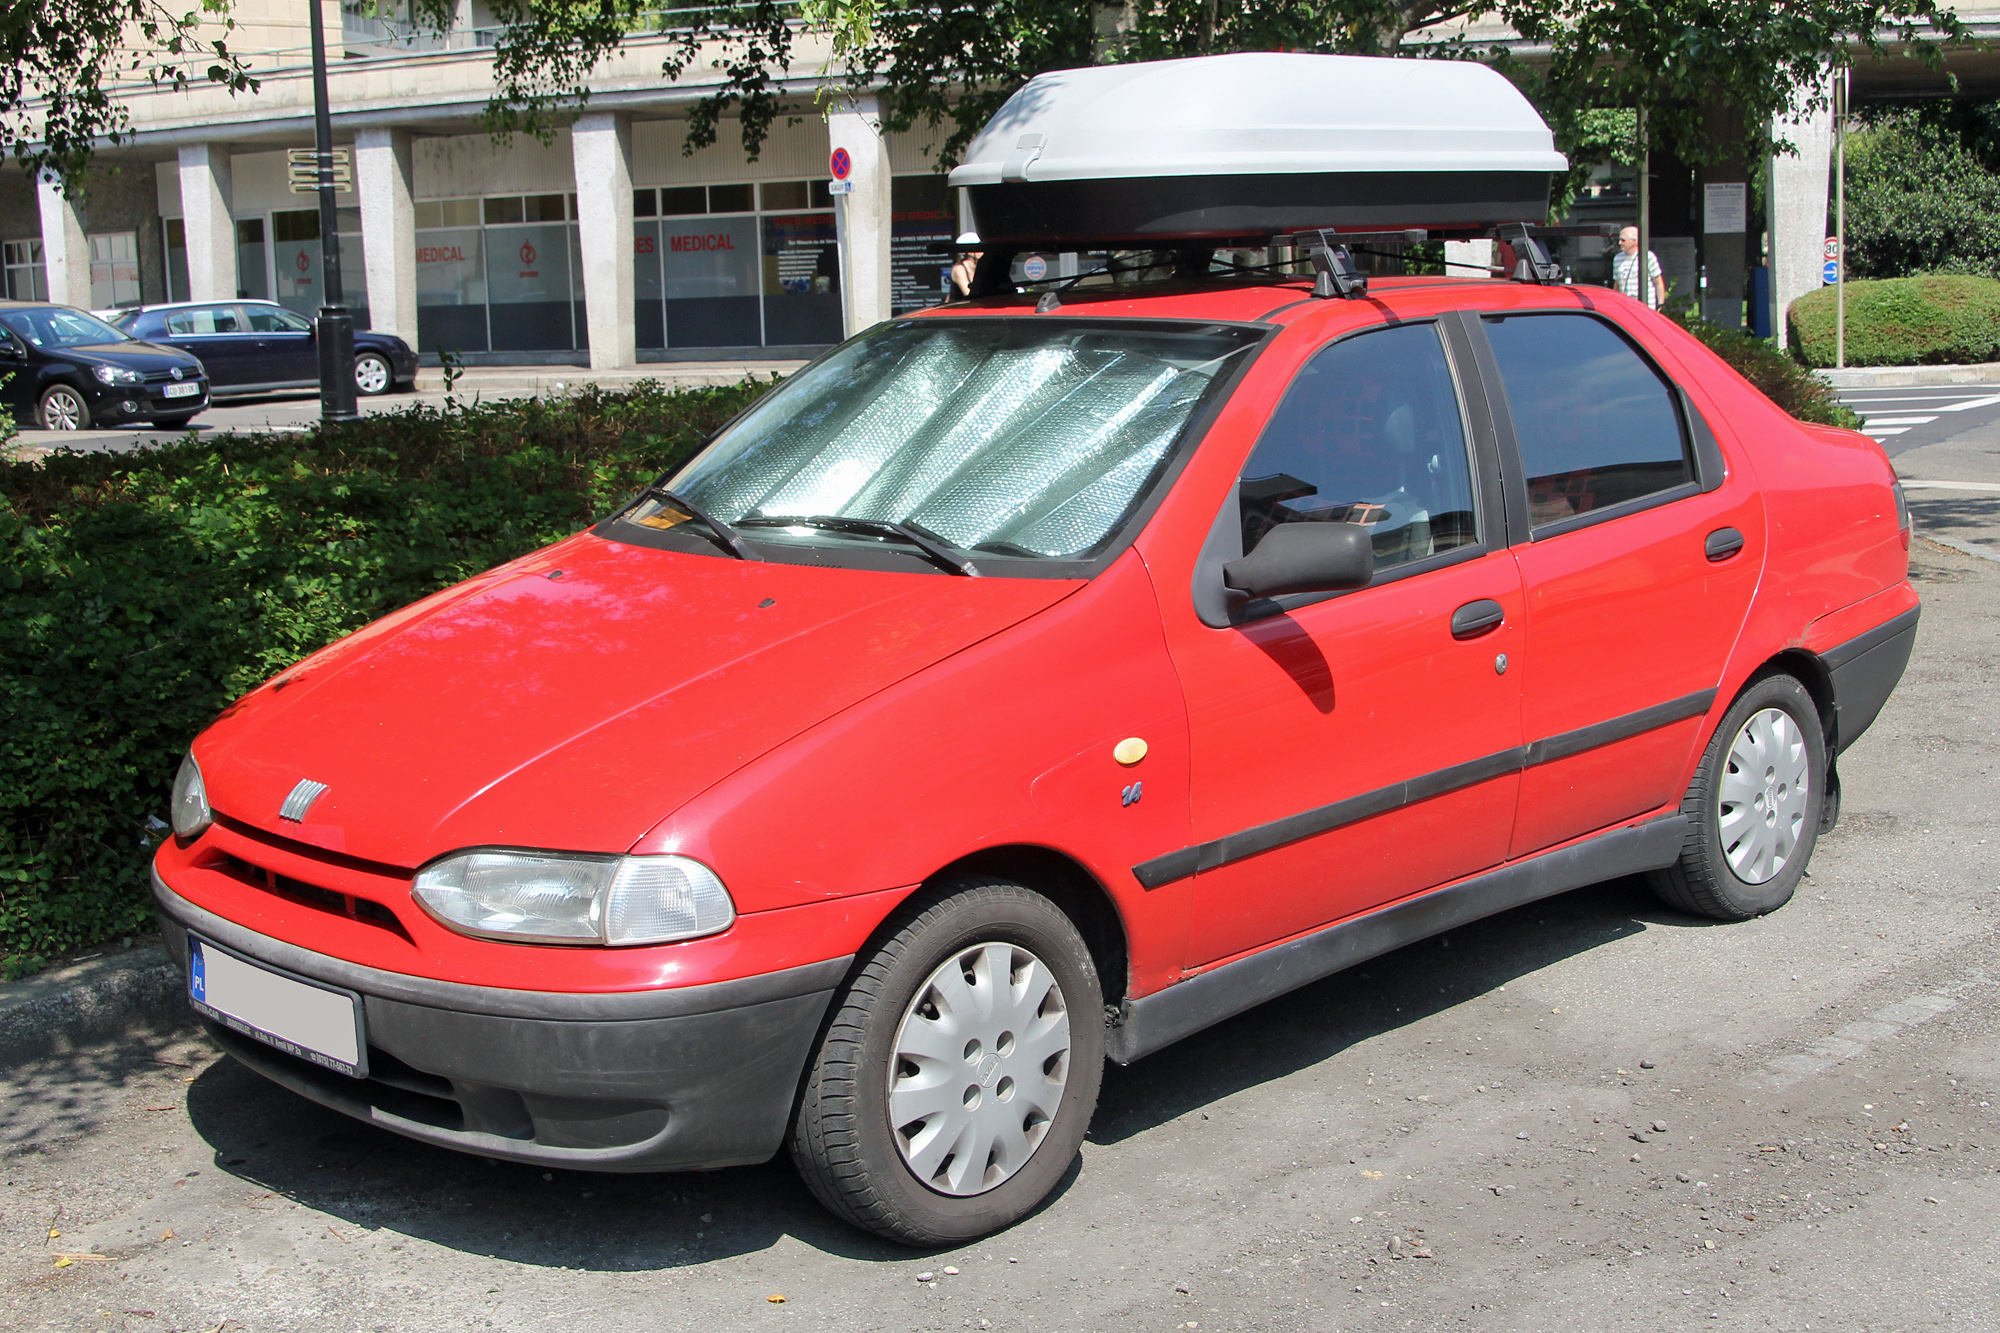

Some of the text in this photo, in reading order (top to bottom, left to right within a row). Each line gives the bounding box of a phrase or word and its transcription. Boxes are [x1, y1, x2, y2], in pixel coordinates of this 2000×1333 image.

[636, 234, 735, 253] ES MEDICAL
[416, 246, 465, 262] MEDICAL
[195, 975, 204, 991] PL
[194, 1000, 220, 1020] INTER-CAR
